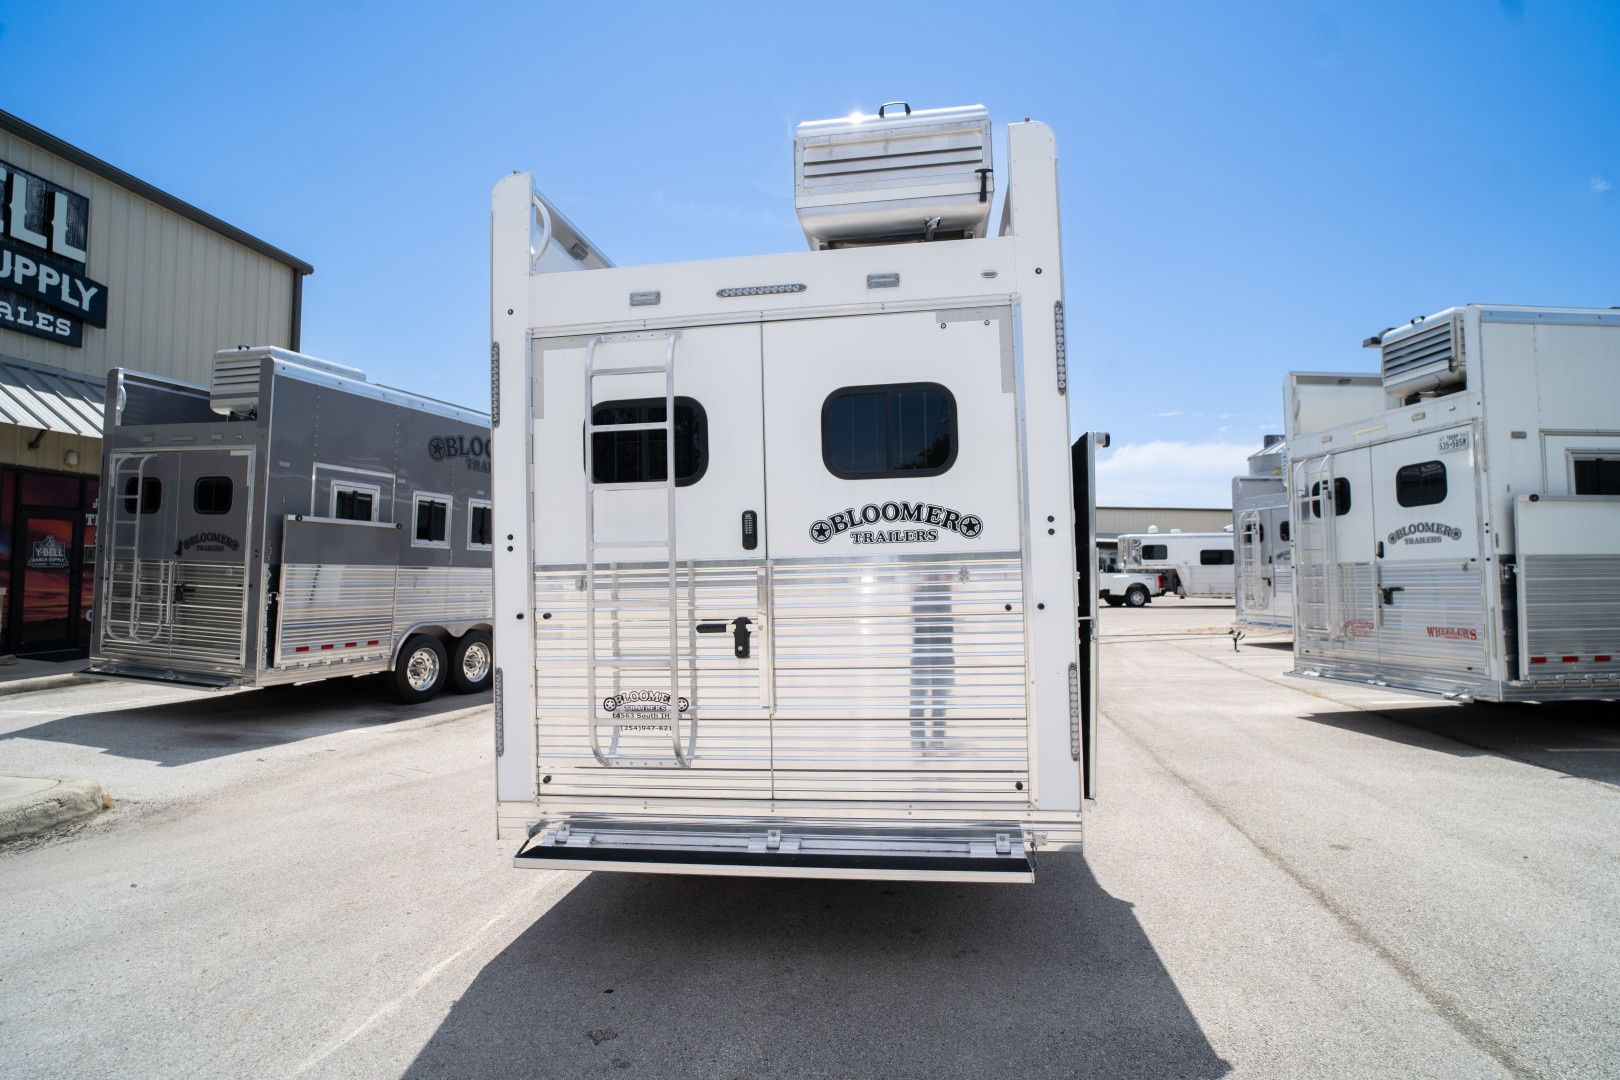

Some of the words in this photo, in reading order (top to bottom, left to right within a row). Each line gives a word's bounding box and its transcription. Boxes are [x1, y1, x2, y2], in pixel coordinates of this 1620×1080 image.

[0, 166, 87, 264] LL
[827, 501, 961, 535] BLOOMER
[850, 529, 938, 544] TRAILERS
[1395, 522, 1452, 540] BLOOMER
[189, 532, 232, 548] BLOOMER
[1404, 536, 1442, 545] TRAILERS
[613, 690, 672, 707] BLOOME
